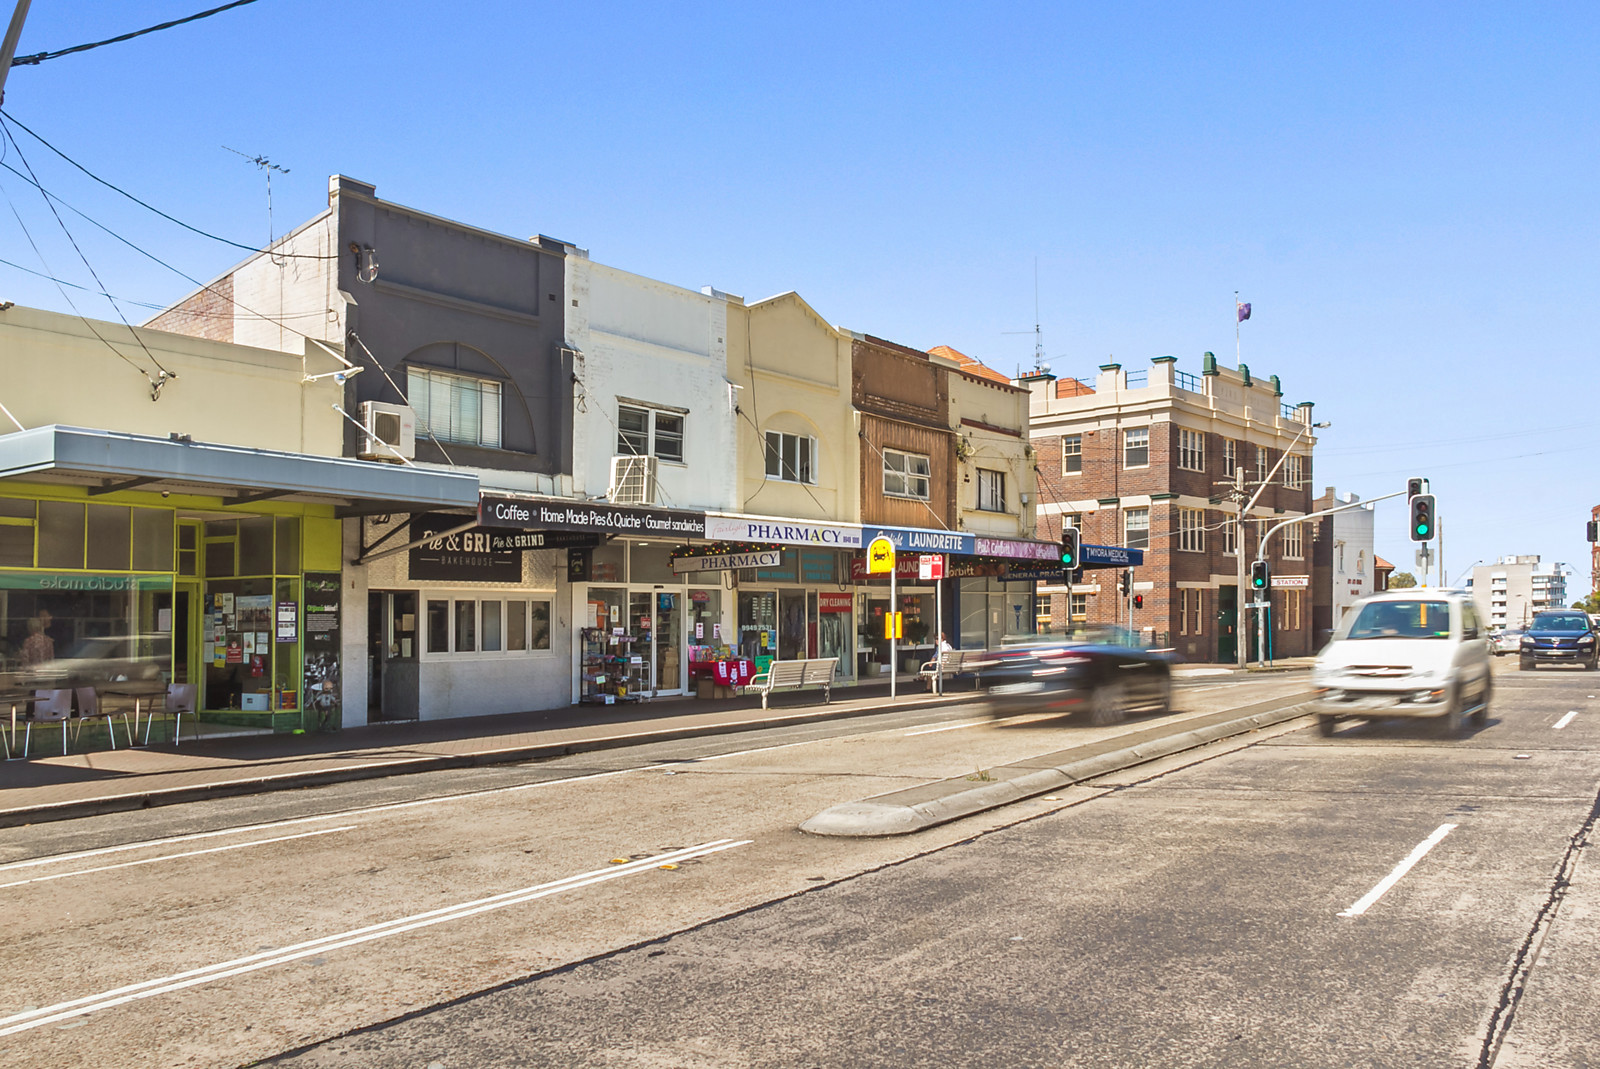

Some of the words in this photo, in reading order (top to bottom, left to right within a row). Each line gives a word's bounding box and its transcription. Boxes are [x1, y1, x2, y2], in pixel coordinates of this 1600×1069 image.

[495, 503, 530, 521] Coffee
[540, 507, 565, 524] Home
[566, 508, 588, 525] Made
[589, 510, 606, 526] Pies
[606, 512, 614, 527] &
[613, 512, 641, 529] Quiche
[645, 514, 671, 530] Gourmet
[671, 518, 704, 533] sandwiches
[747, 523, 841, 543] PHARMACY
[446, 533, 461, 552] &
[492, 535, 505, 548] Pie
[505, 535, 514, 548] &
[514, 534, 545, 548] GRIND
[908, 532, 963, 550] LAUNDRETTE
[441, 555, 493, 567] BAKEHOUSE
[701, 553, 778, 569] PHARMACY
[1107, 549, 1129, 559] MEDICAL
[1002, 571, 1037, 579] GENERAL
[829, 598, 851, 607] CLEANING
